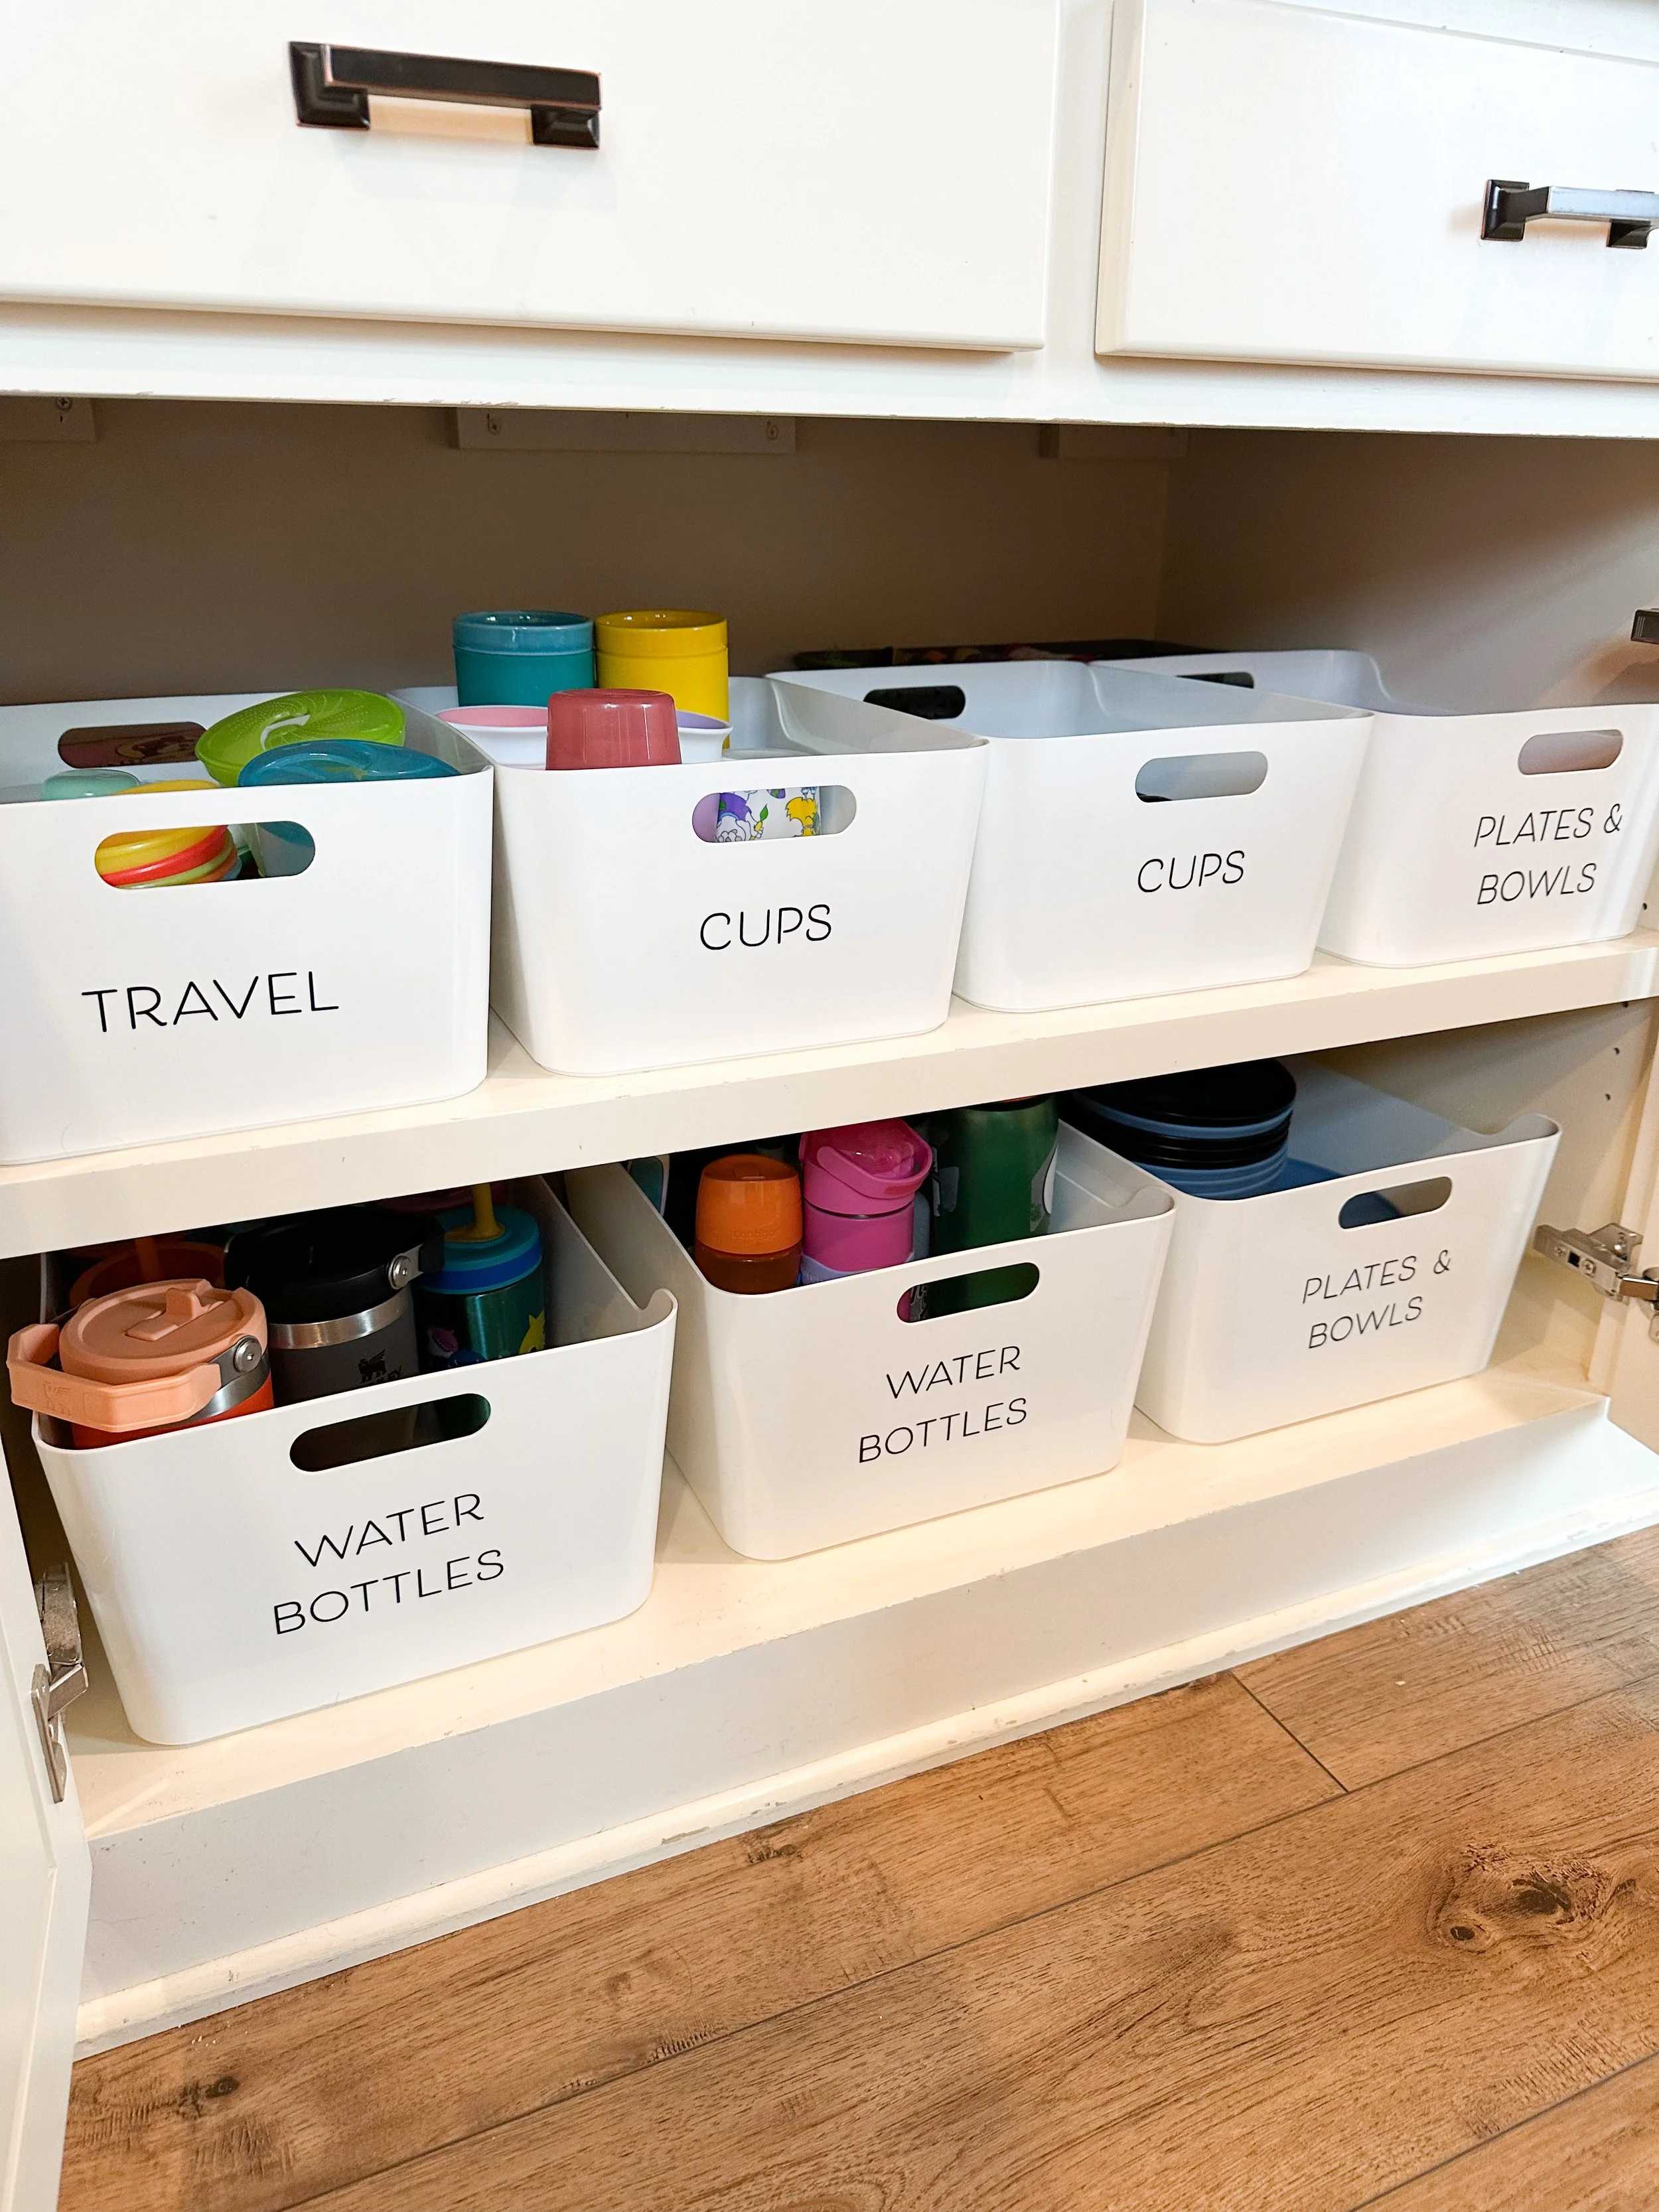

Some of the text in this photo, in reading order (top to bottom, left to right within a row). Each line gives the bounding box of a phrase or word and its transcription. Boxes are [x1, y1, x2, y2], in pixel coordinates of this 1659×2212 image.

[1473, 803, 1624, 848] PLATES &
[1137, 849, 1246, 893] CUPS
[1477, 862, 1598, 905] BOWLS
[699, 904, 833, 950] CUPS
[81, 971, 340, 1033] TRAVEL
[1301, 1249, 1451, 1305] PLATES &
[1308, 1295, 1423, 1349] BOWLS
[886, 1345, 1021, 1400] WATER
[858, 1397, 1028, 1464] BOTTLES
[294, 1493, 485, 1568] WATER
[273, 1549, 504, 1636] BOTTLES
